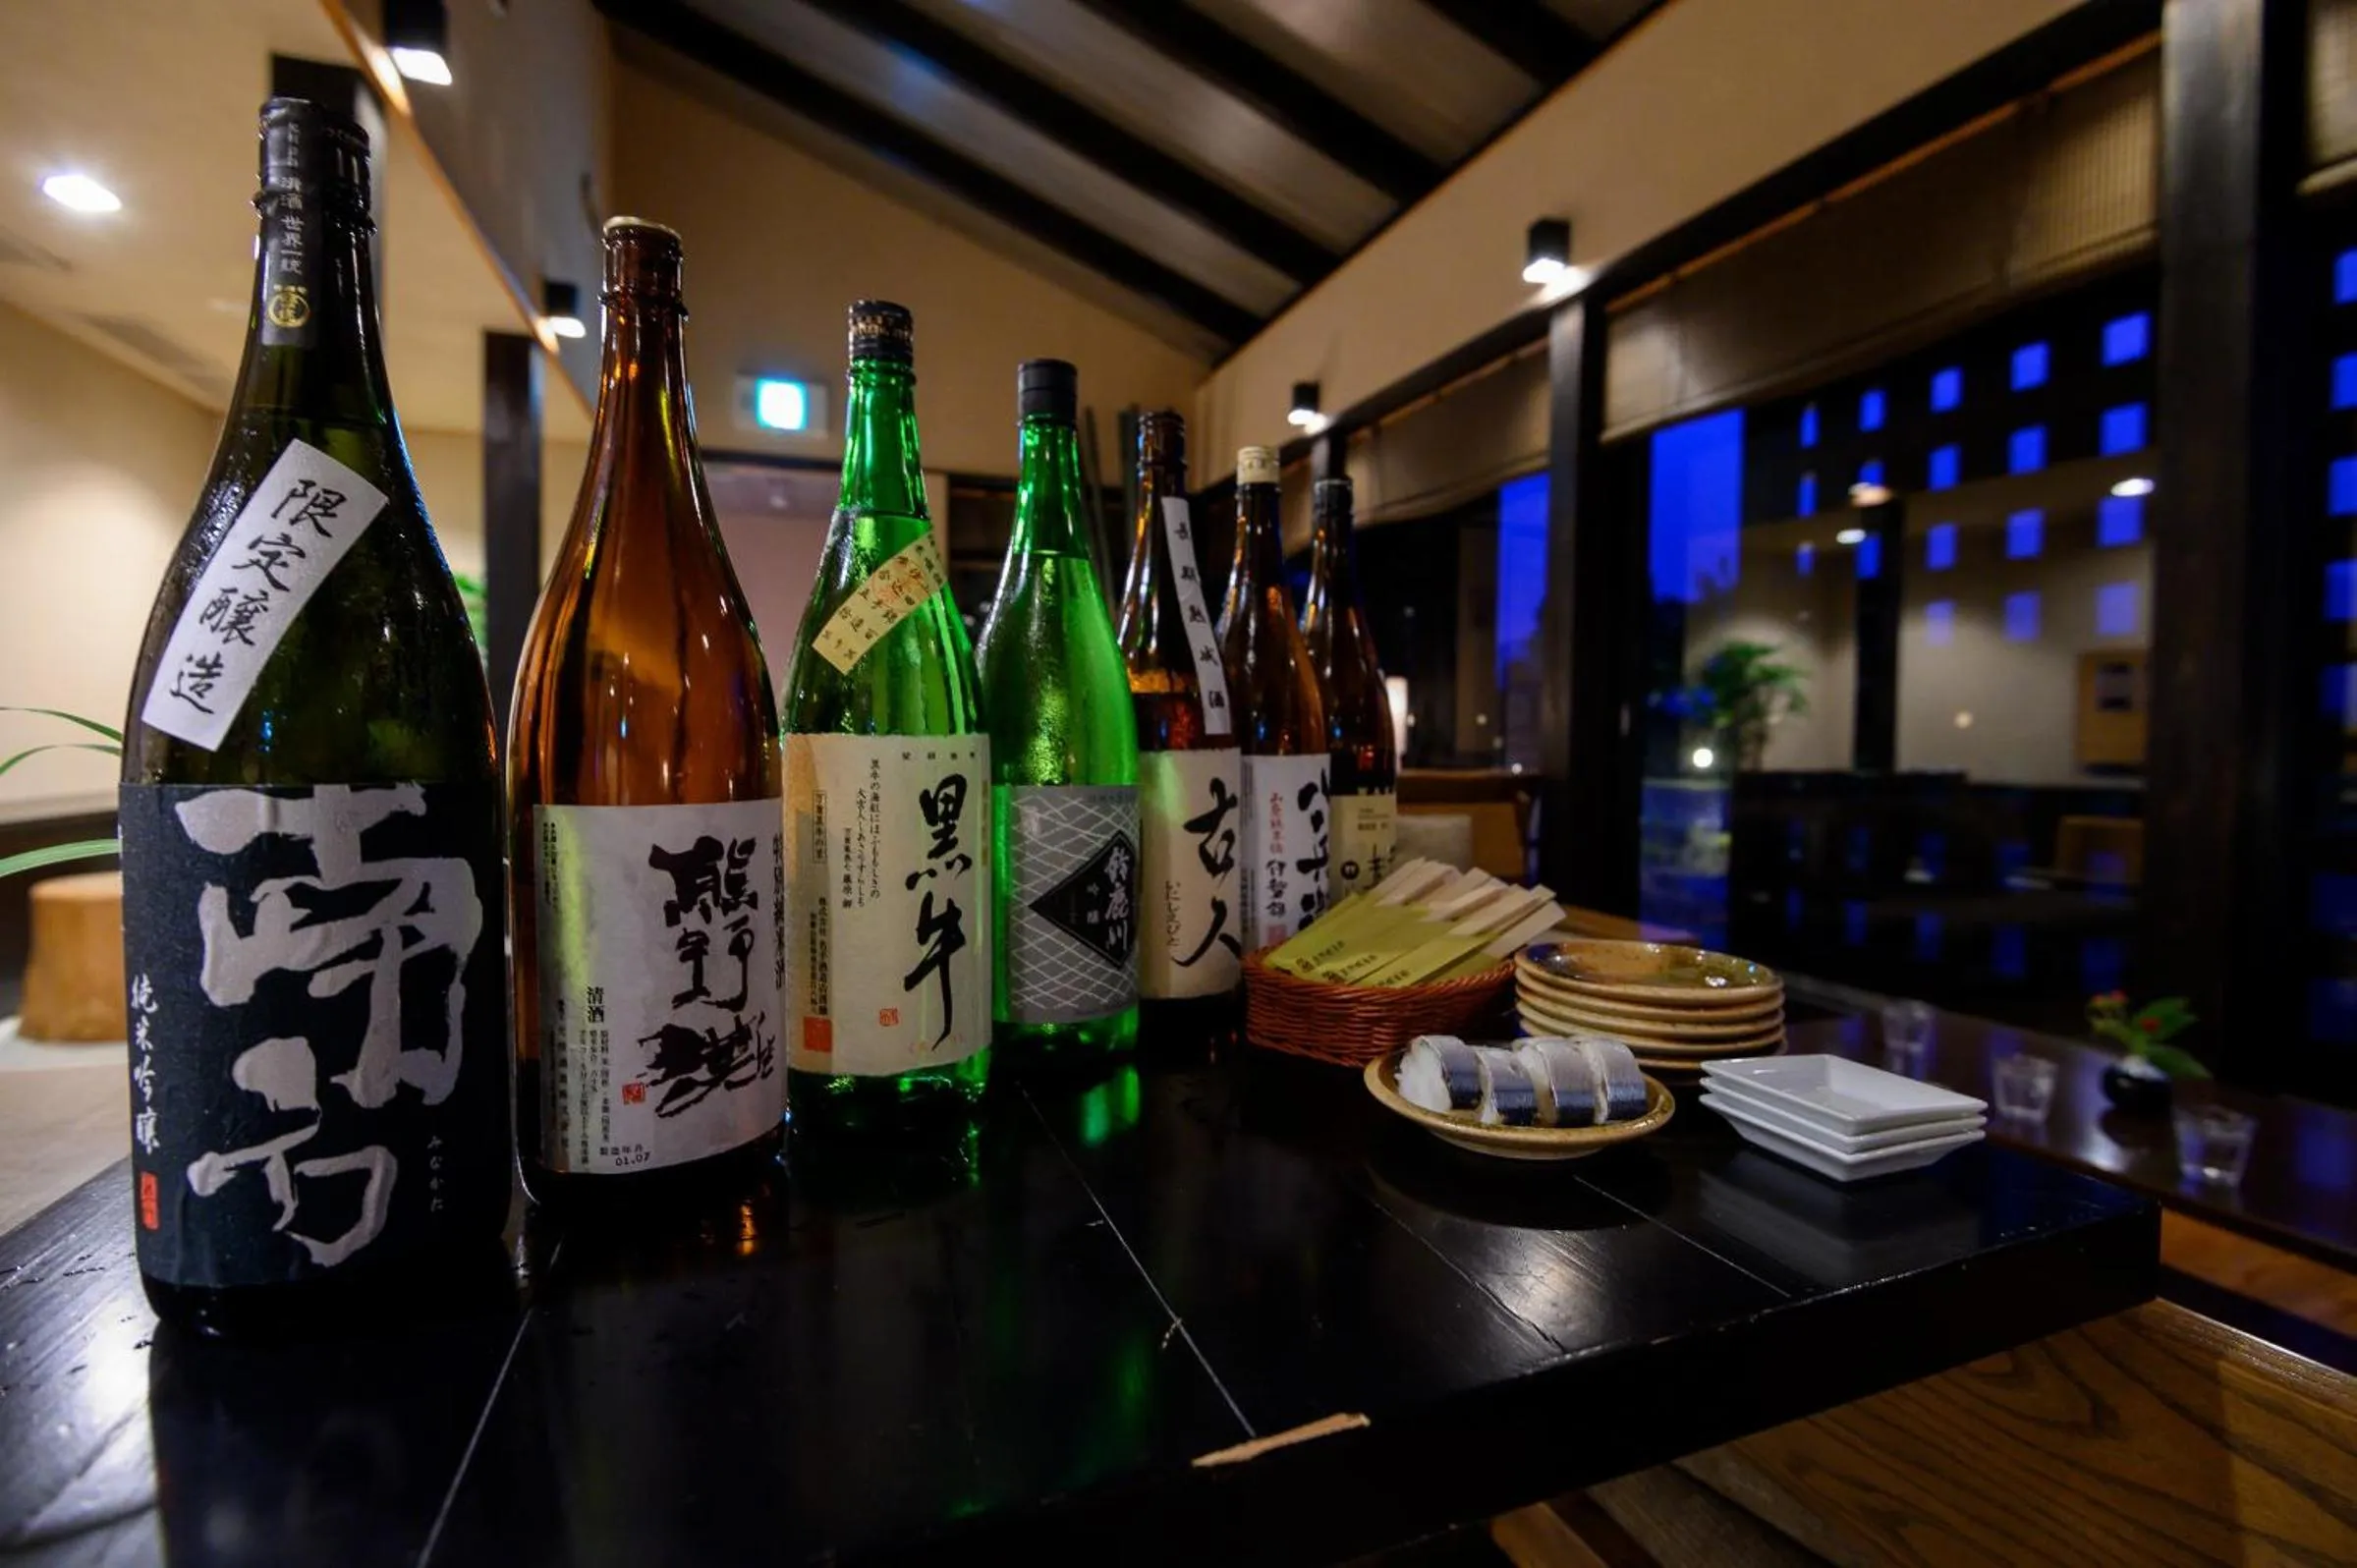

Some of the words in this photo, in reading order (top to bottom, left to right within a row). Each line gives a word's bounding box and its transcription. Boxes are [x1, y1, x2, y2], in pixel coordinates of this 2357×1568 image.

[168, 478, 348, 715] 限定醸造
[903, 773, 974, 1051] 黒牛
[1170, 777, 1243, 968] 古人
[587, 985, 605, 1024] 清酒
[615, 1152, 651, 1167] 01.07
